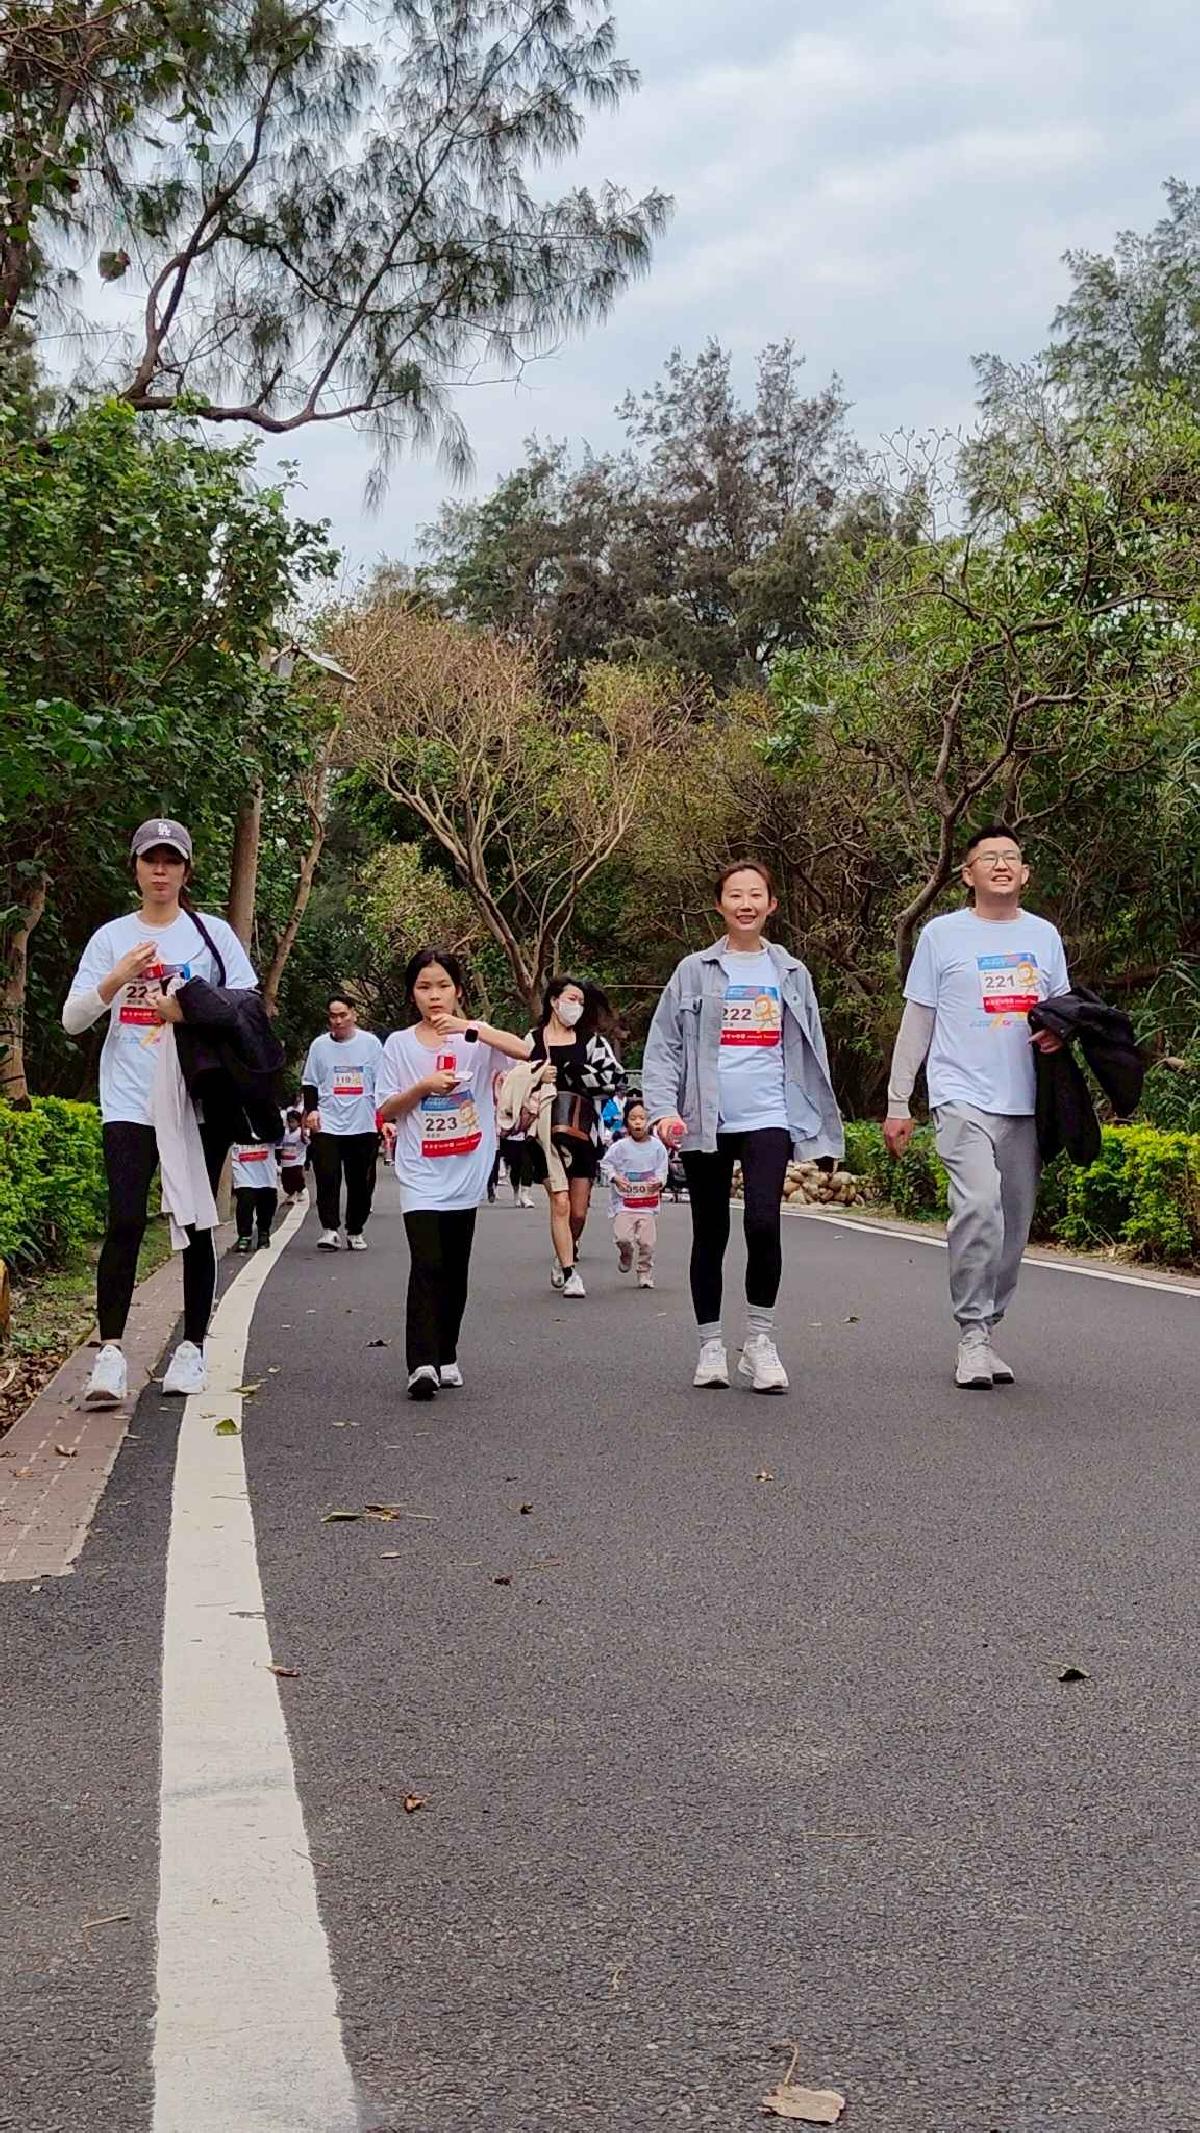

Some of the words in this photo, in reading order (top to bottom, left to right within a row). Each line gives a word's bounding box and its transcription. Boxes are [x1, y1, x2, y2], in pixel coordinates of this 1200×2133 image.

[984, 974, 1015, 989] 221
[126, 985, 149, 999] 22
[721, 1007, 752, 1021] 222
[425, 1116, 458, 1132] 223
